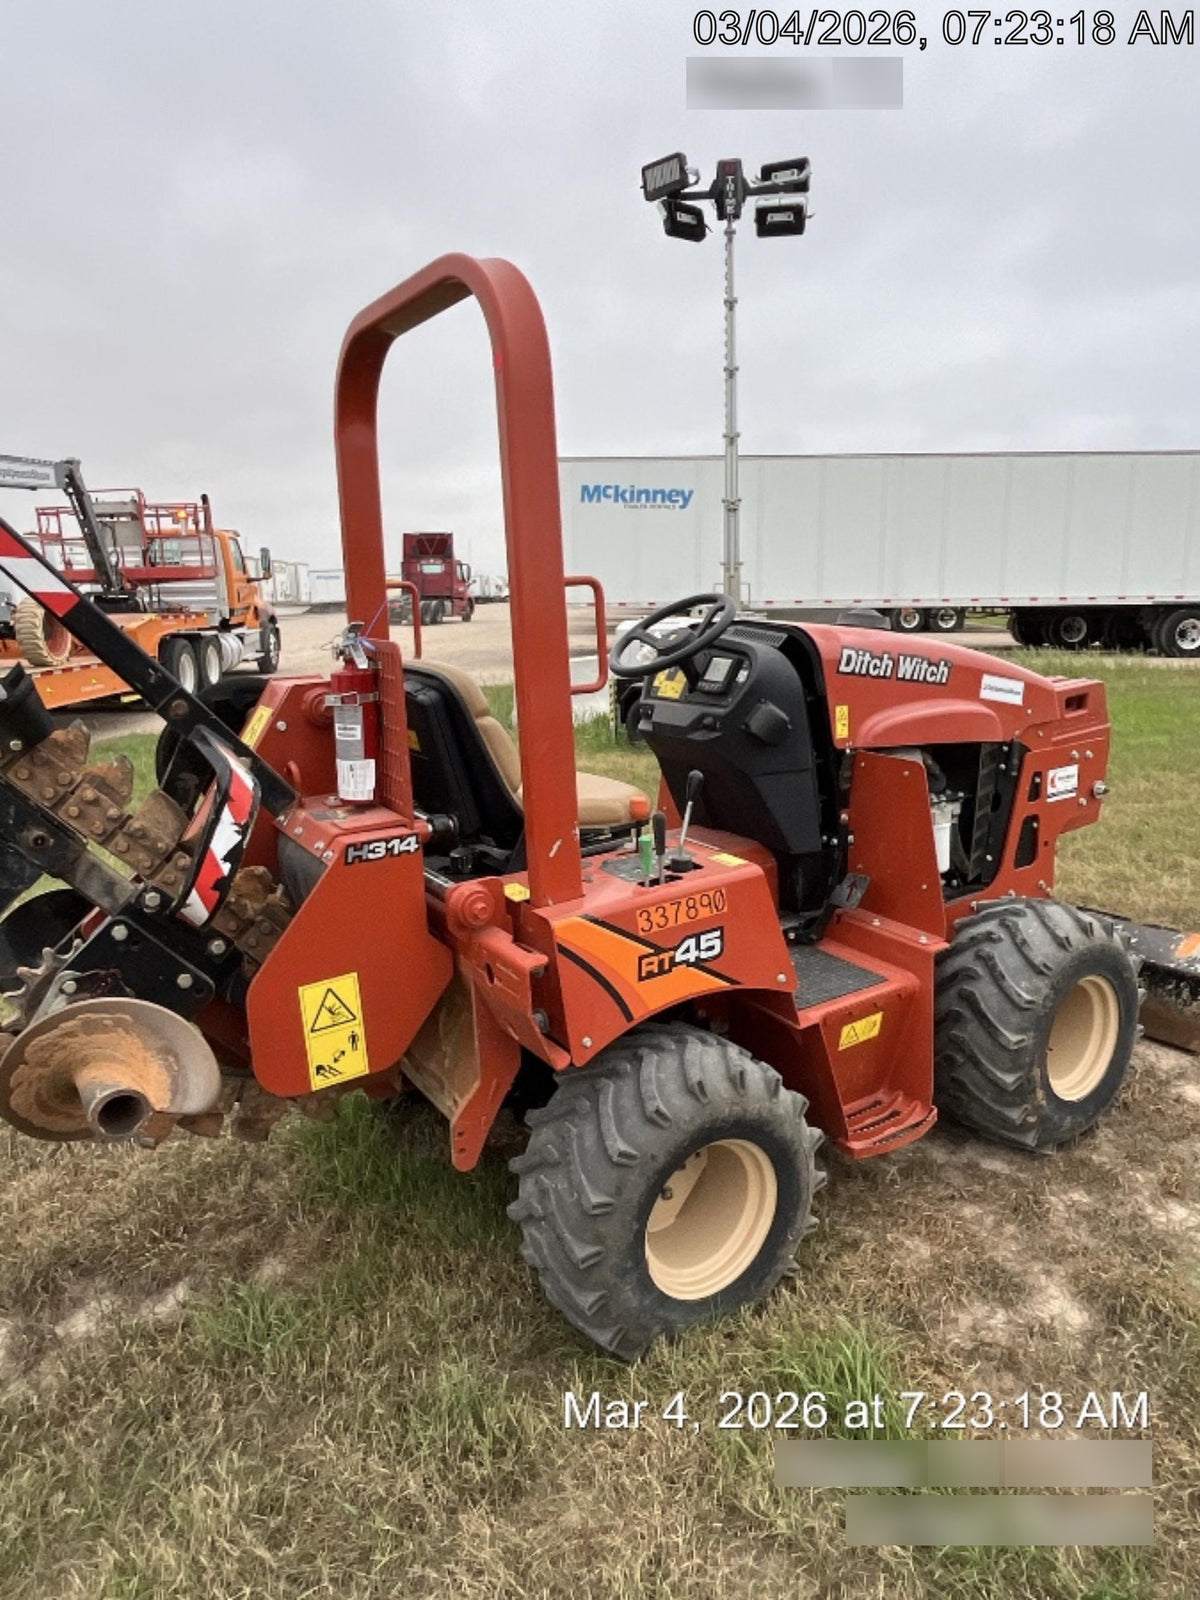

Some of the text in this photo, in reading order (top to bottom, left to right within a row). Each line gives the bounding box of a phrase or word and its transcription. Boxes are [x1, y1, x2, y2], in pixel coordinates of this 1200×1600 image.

[838, 648, 949, 684] Ditch Witch
[346, 834, 420, 864] H314
[638, 888, 727, 934] 337890
[640, 929, 723, 980] RT45
